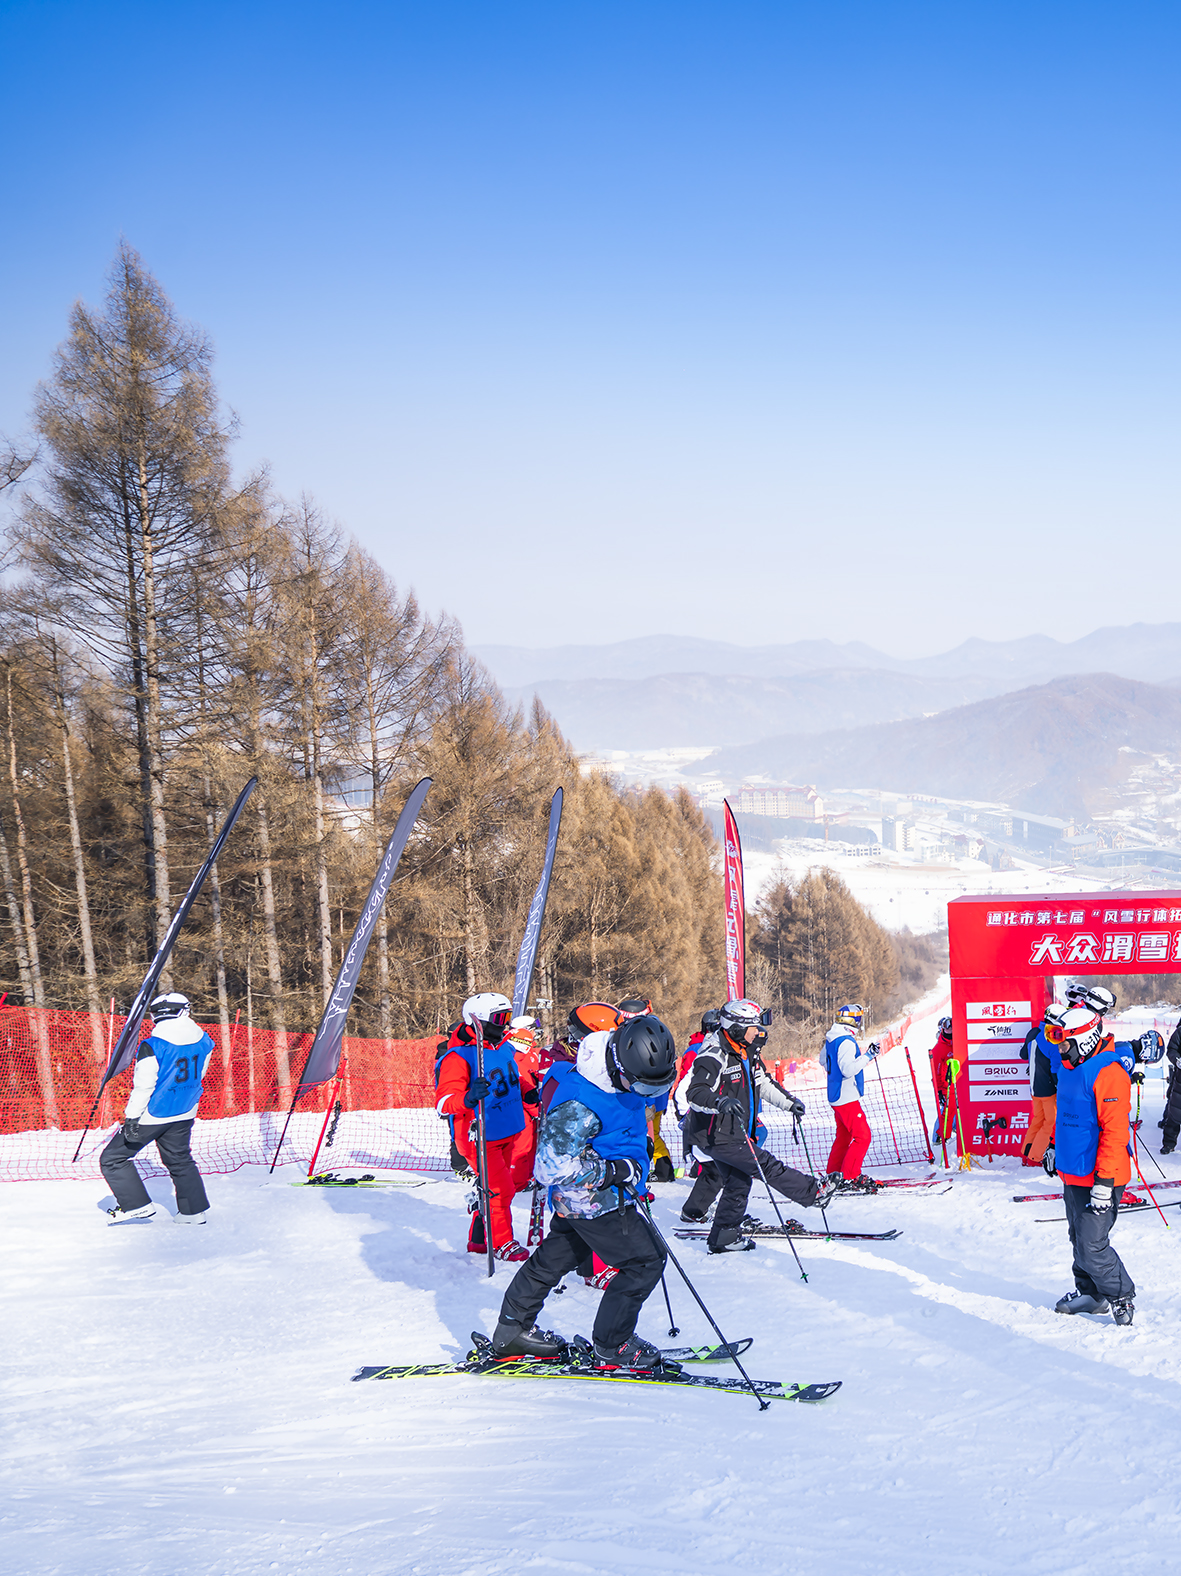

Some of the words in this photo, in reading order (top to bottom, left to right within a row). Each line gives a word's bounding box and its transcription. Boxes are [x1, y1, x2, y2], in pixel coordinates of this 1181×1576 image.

[174, 1054, 200, 1084] 31
[984, 1067, 1019, 1075] BRIKO
[489, 1061, 520, 1098] 34
[972, 1134, 1026, 1145] SKIIN
